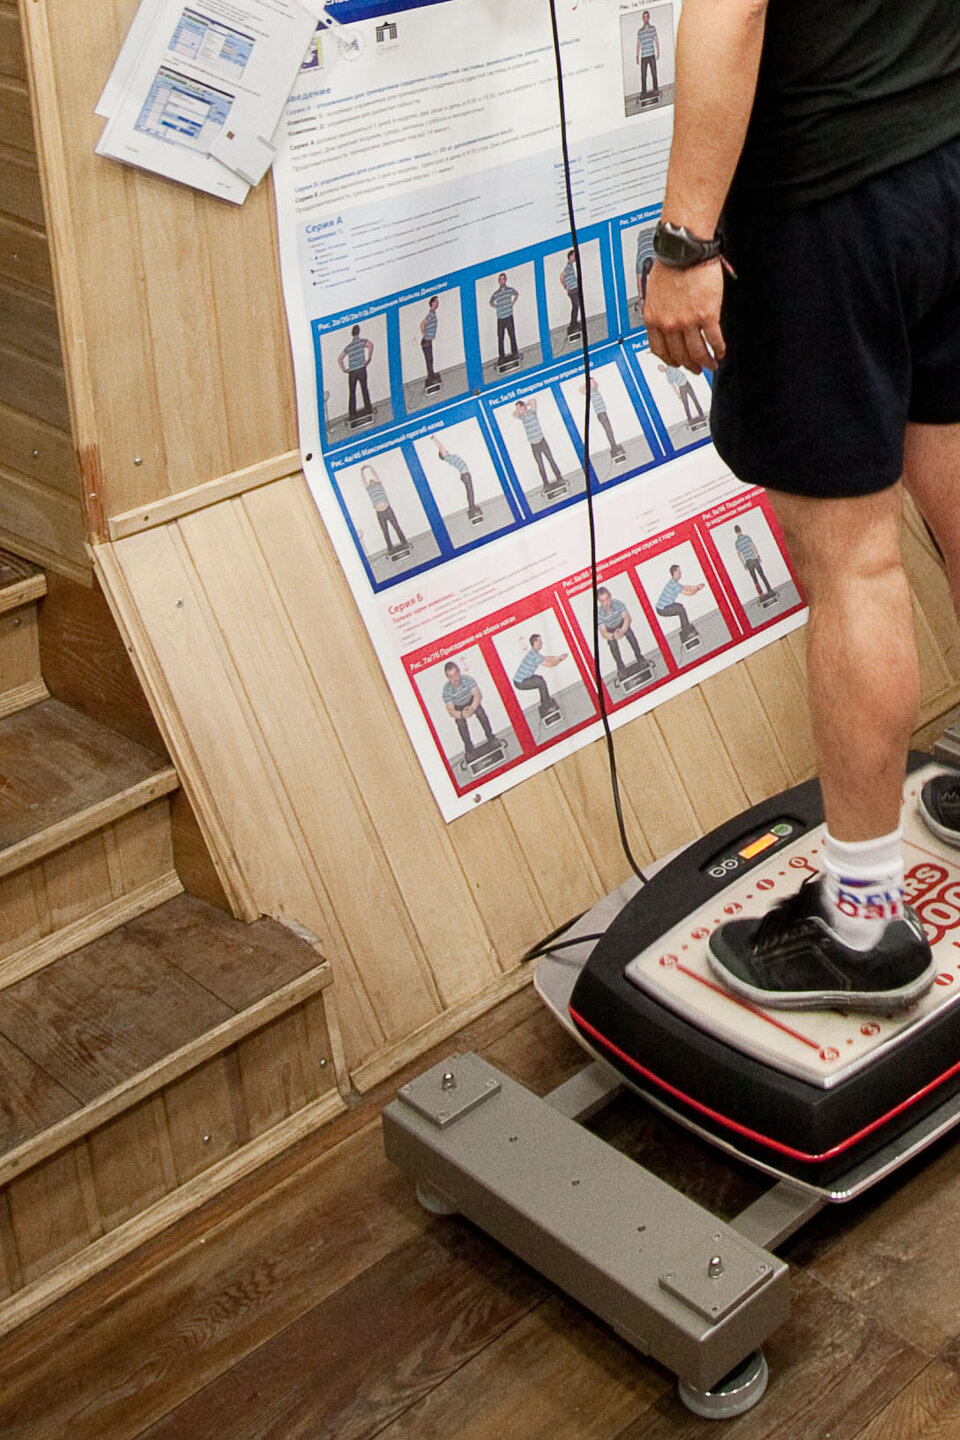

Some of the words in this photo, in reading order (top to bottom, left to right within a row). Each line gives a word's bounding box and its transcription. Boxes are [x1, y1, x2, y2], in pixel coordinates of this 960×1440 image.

[305, 221, 336, 235] Серия
[388, 598, 415, 616] Серия
[416, 593, 424, 603] Б
[903, 864, 950, 903] ARS
